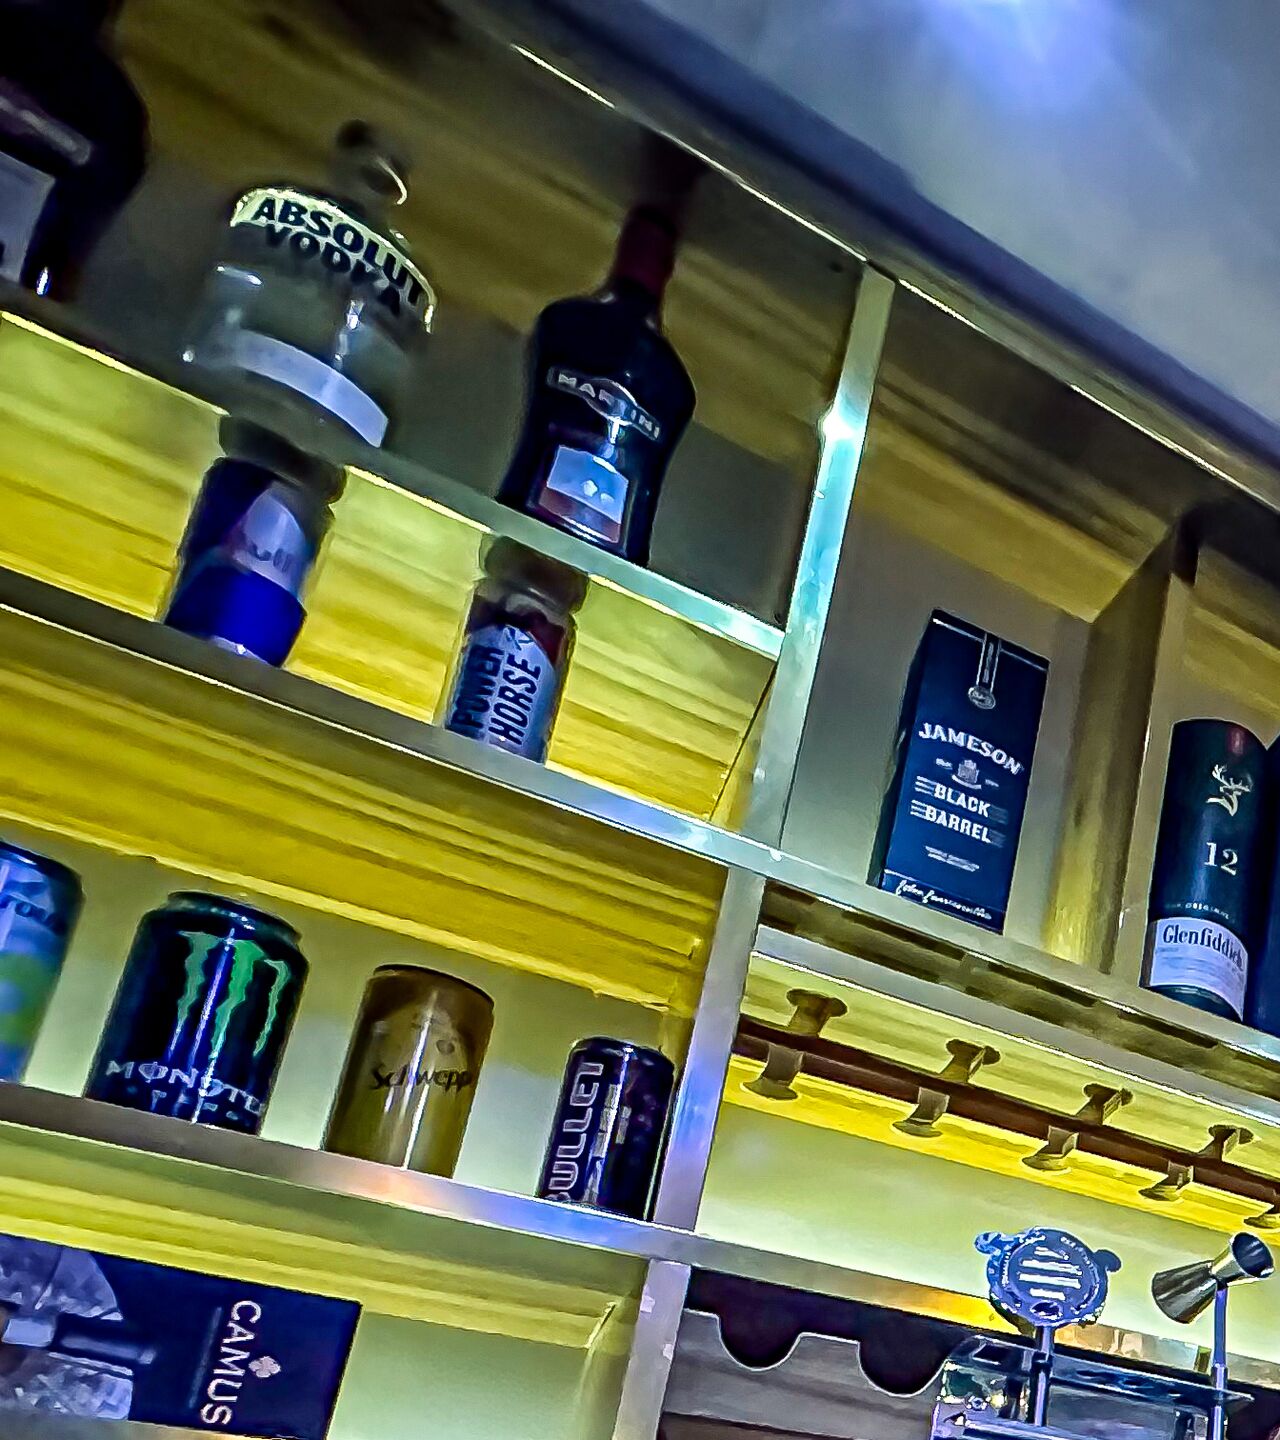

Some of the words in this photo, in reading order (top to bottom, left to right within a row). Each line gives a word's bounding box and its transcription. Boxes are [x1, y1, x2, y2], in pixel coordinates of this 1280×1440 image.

[250, 197, 425, 307] ABSOLUT
[266, 222, 402, 317] VODKA
[451, 645, 505, 729] POWER
[488, 654, 542, 746] HORSE
[918, 722, 1023, 776] JAMESON
[923, 804, 992, 844] BARREL
[933, 783, 992, 818] BLACK
[1203, 841, 1239, 876] 12
[1163, 924, 1245, 972] Glenfiddich
[201, 1300, 262, 1425] CAMUS
